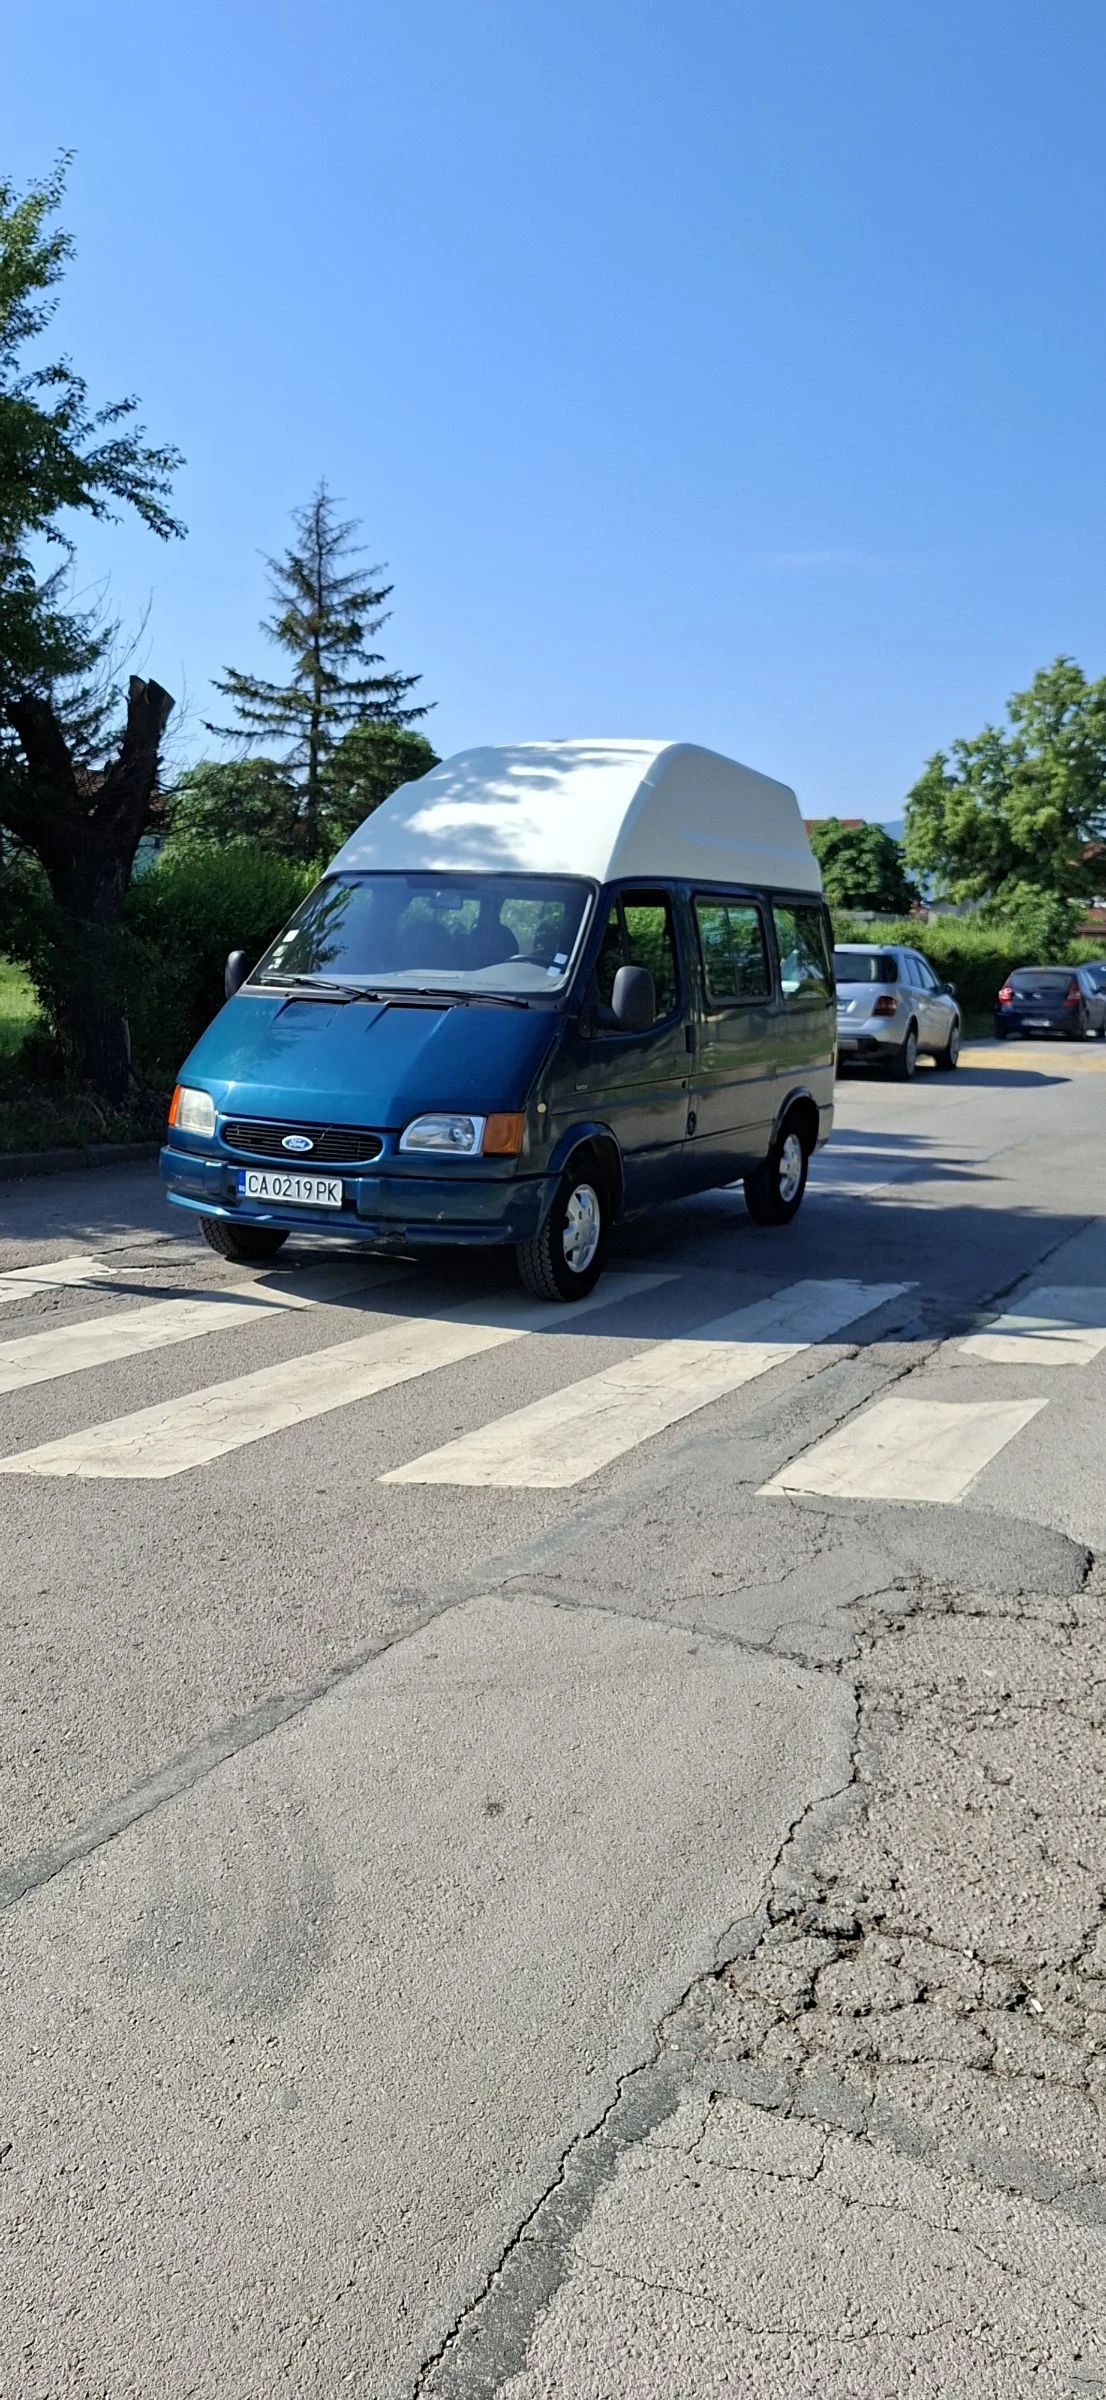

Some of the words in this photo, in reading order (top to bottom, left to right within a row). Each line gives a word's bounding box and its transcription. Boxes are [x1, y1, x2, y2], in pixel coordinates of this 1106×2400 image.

[249, 1175, 268, 1194] CA
[272, 1177, 312, 1199] 0219
[316, 1181, 337, 1201] PK
